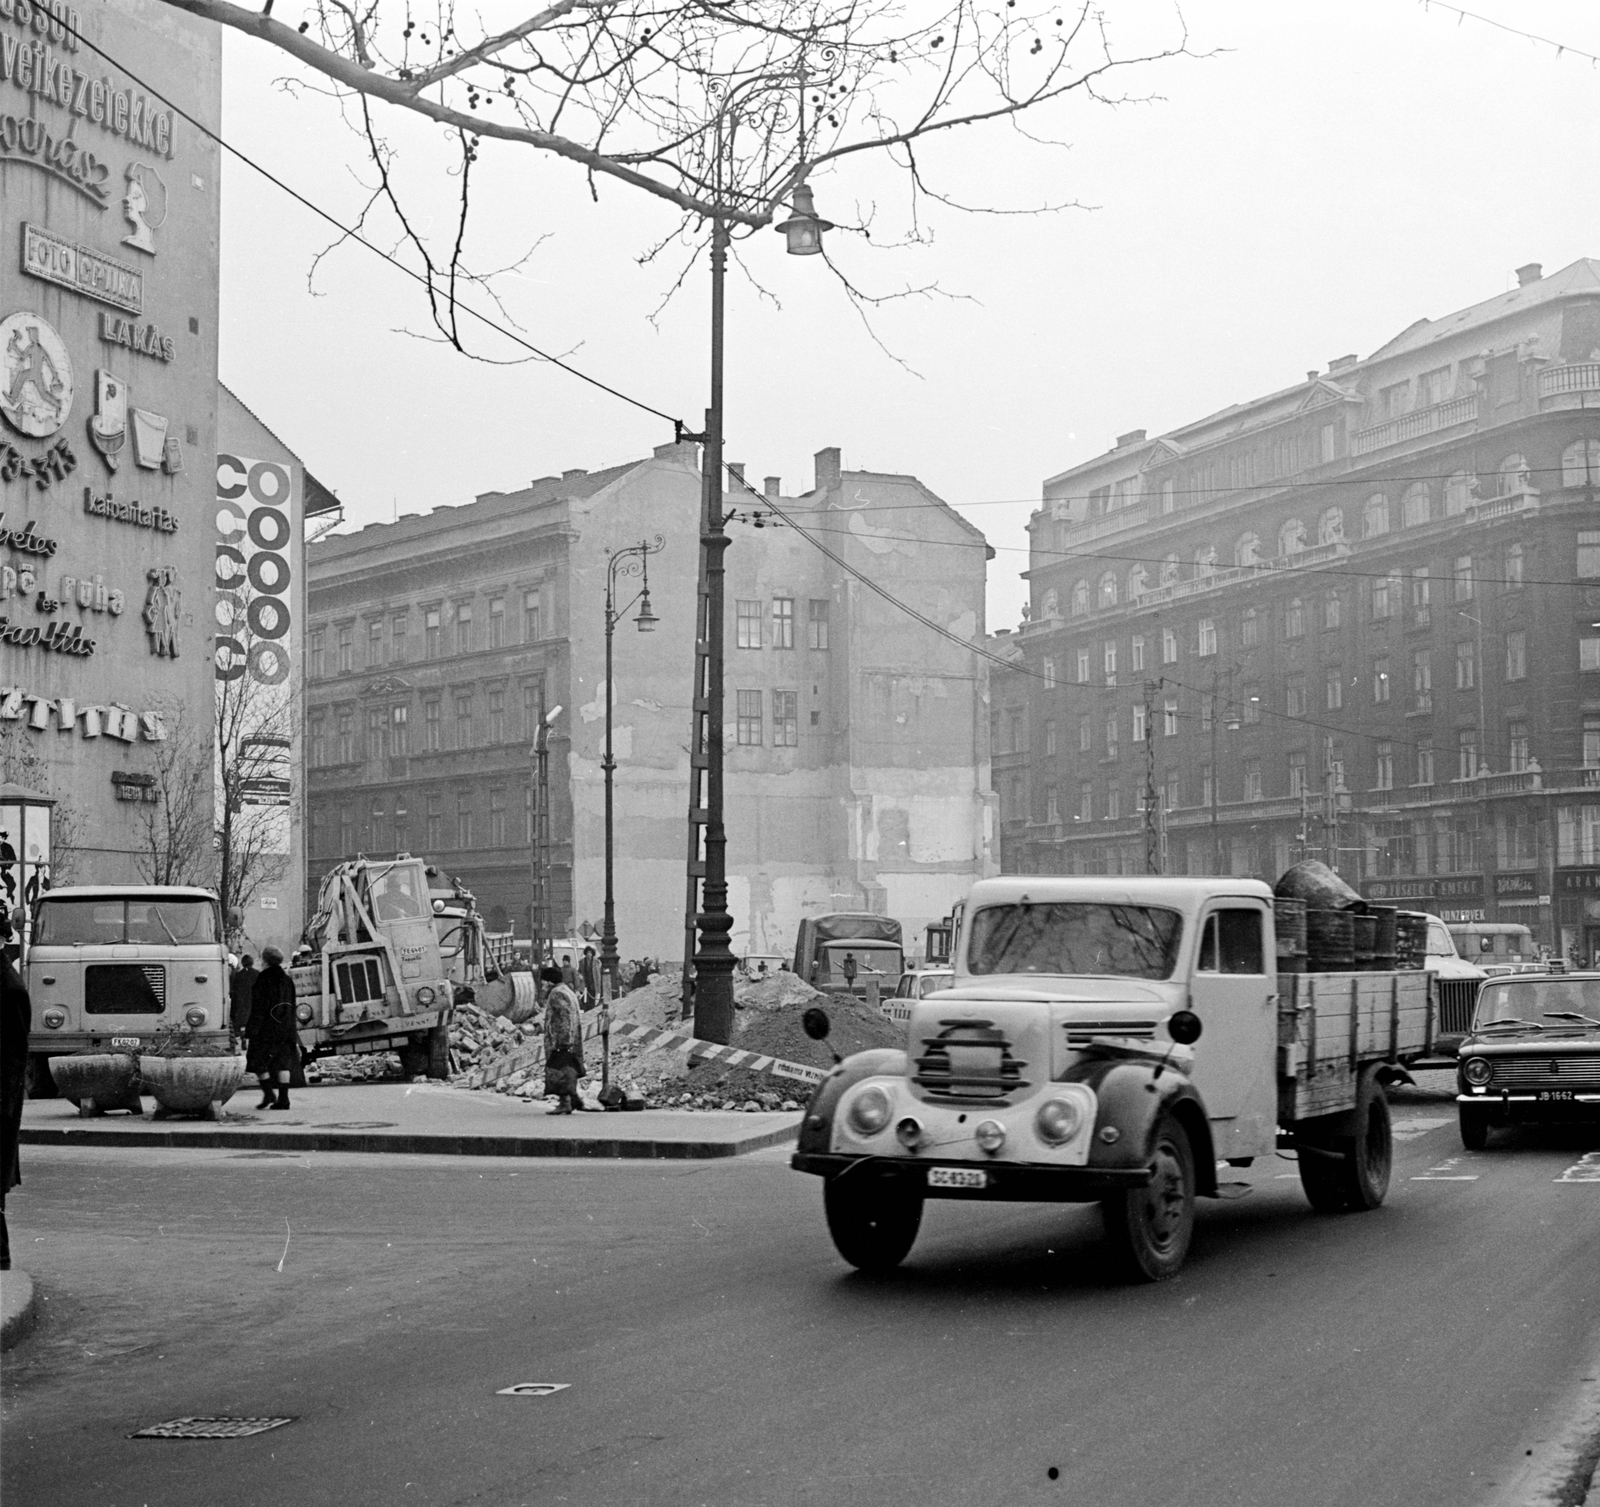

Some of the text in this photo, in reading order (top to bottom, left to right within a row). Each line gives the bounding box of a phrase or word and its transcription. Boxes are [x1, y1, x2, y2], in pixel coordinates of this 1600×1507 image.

[28, 235, 71, 276] FOTO
[102, 312, 177, 362] LAKÁS
[64, 574, 125, 617] ruha
[1440, 908, 1486, 921] KONZERVEK
